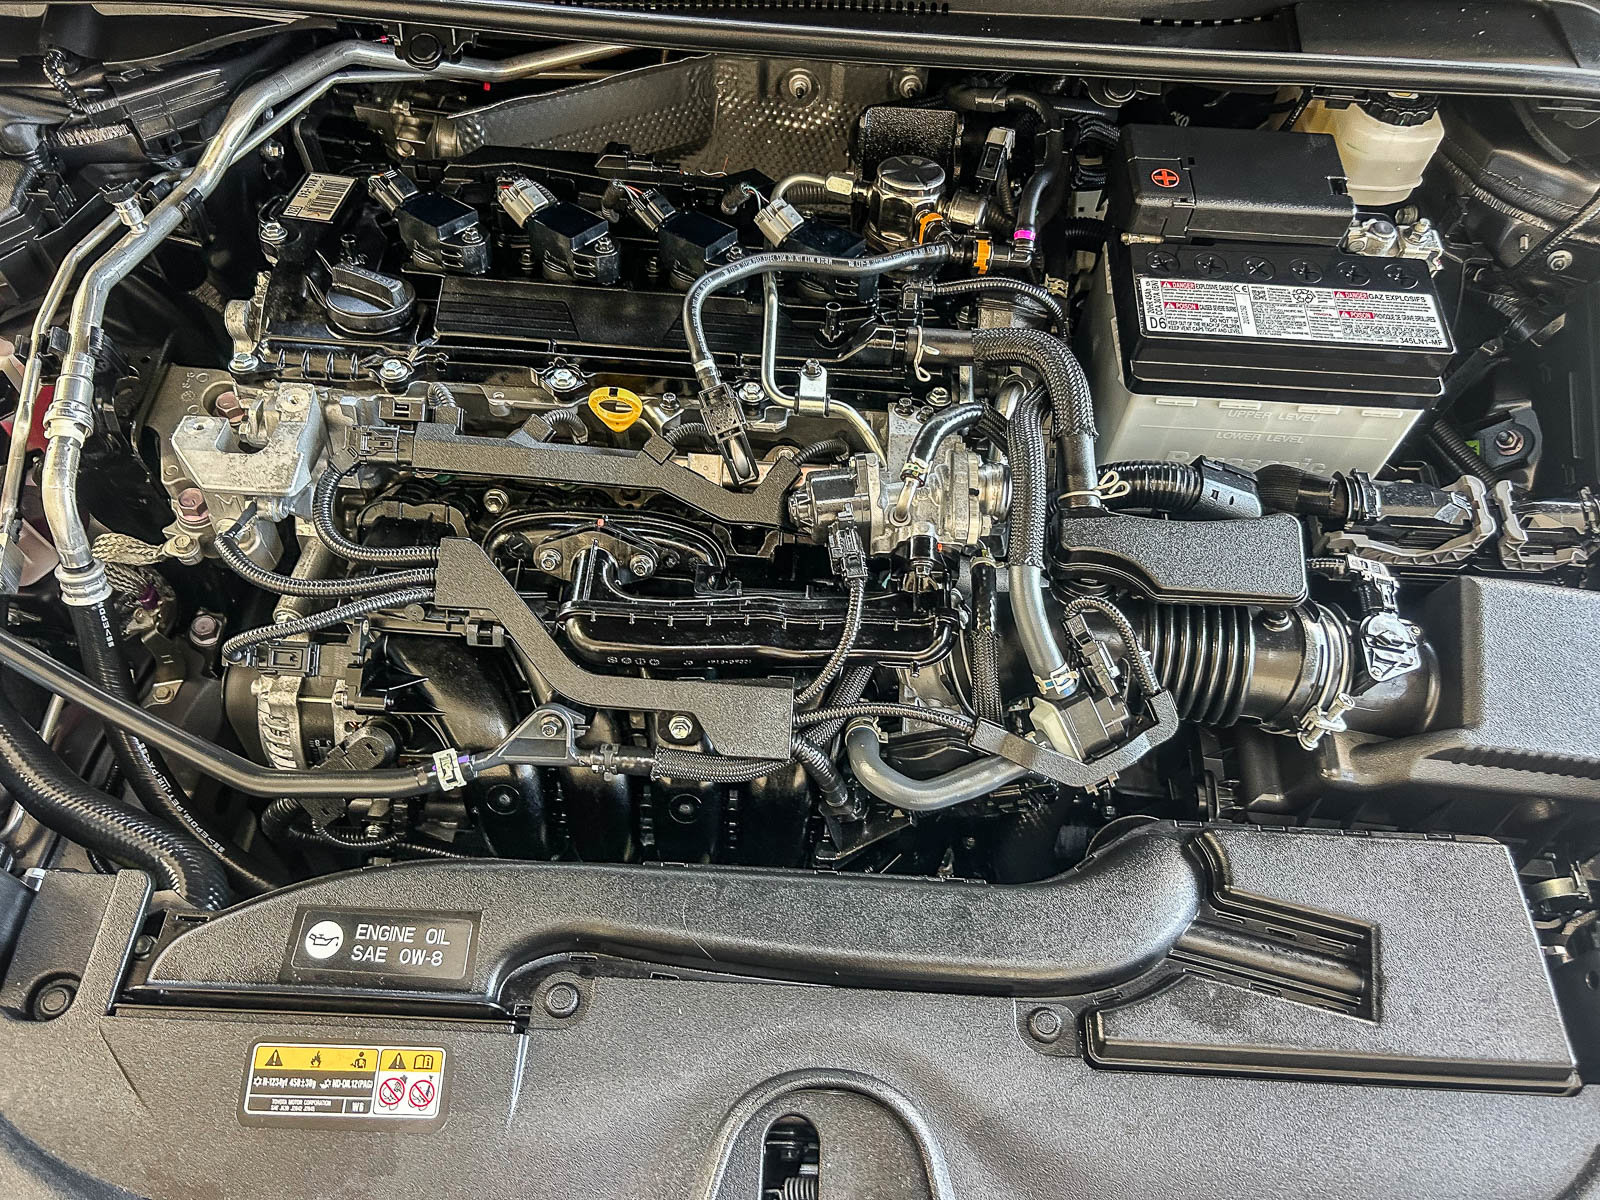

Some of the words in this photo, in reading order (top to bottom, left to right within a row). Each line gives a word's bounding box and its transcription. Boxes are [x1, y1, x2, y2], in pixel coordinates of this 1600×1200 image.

[1195, 283, 1218, 291] EXPLOSIVE
[1385, 295, 1426, 303] EXPLOSIFS
[1150, 317, 1167, 330] D6
[1400, 337, 1443, 346] 345LN1-MF
[1228, 409, 1273, 420] UPPER
[1278, 413, 1321, 423] LEVEL
[1216, 431, 1263, 442] LOWER
[1266, 434, 1306, 444] LEVEL
[355, 923, 417, 943] ENGINE
[425, 928, 451, 946] OIL
[351, 945, 389, 963] SAE
[399, 948, 444, 967] 0W-8
[352, 1101, 365, 1112] W6
